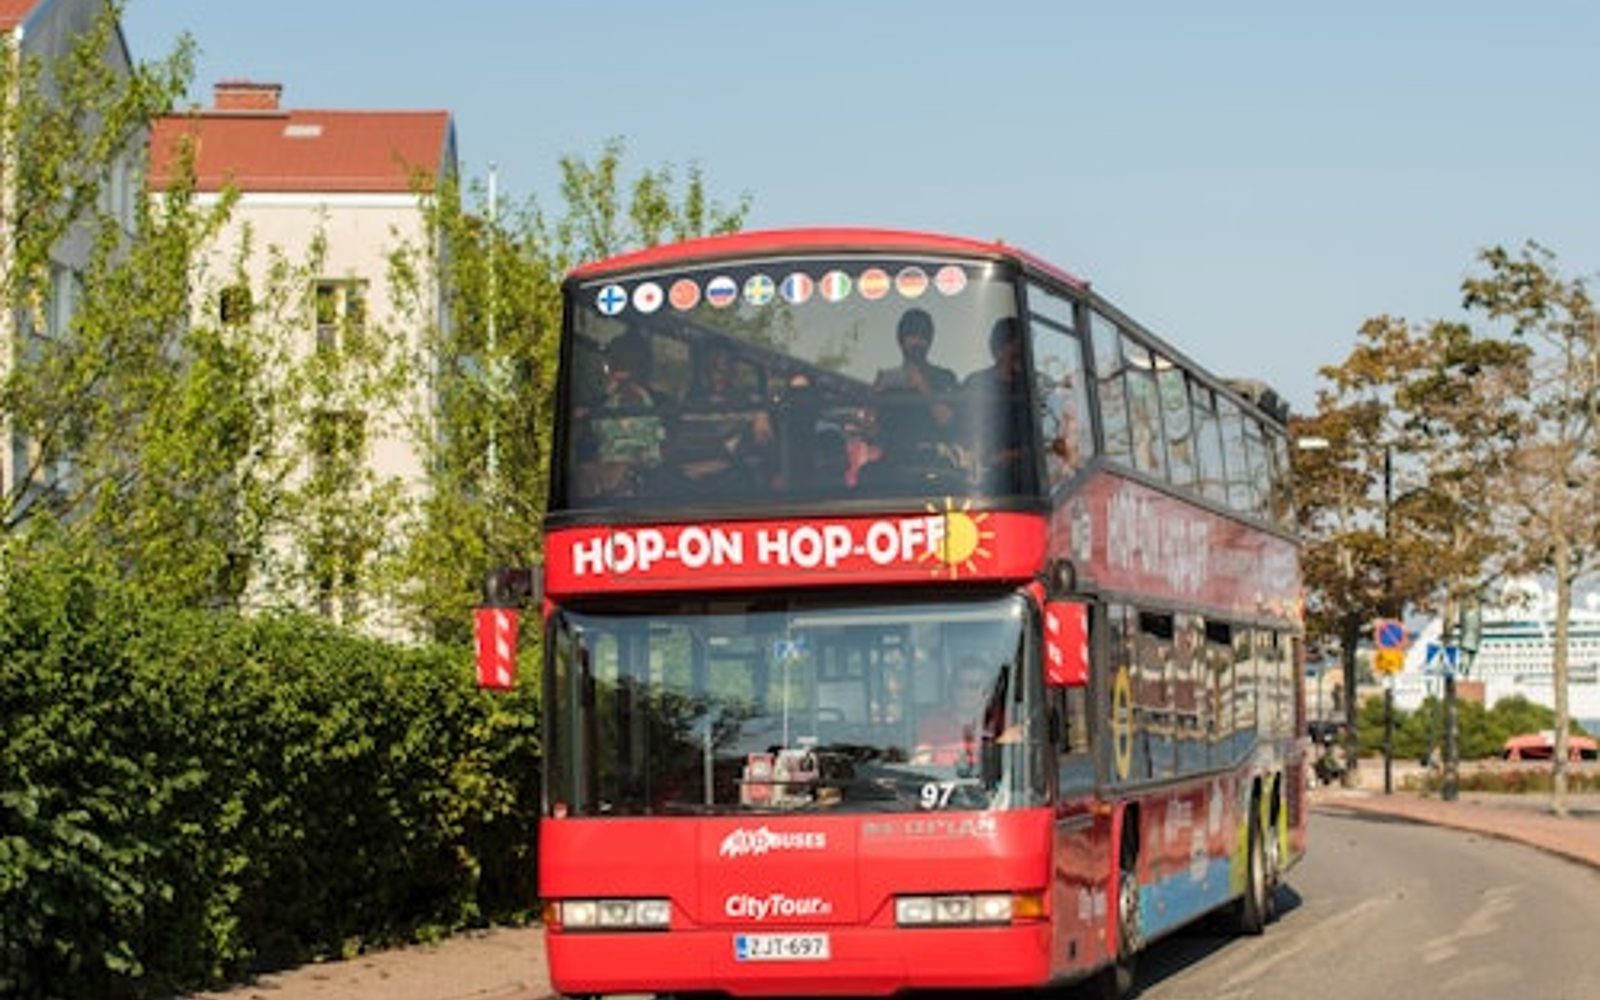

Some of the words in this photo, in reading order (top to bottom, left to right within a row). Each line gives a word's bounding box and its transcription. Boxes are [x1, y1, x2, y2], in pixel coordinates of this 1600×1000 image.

[573, 527, 743, 575] HOP-ON
[758, 515, 945, 566] HOP-OFF
[921, 782, 955, 808] 97
